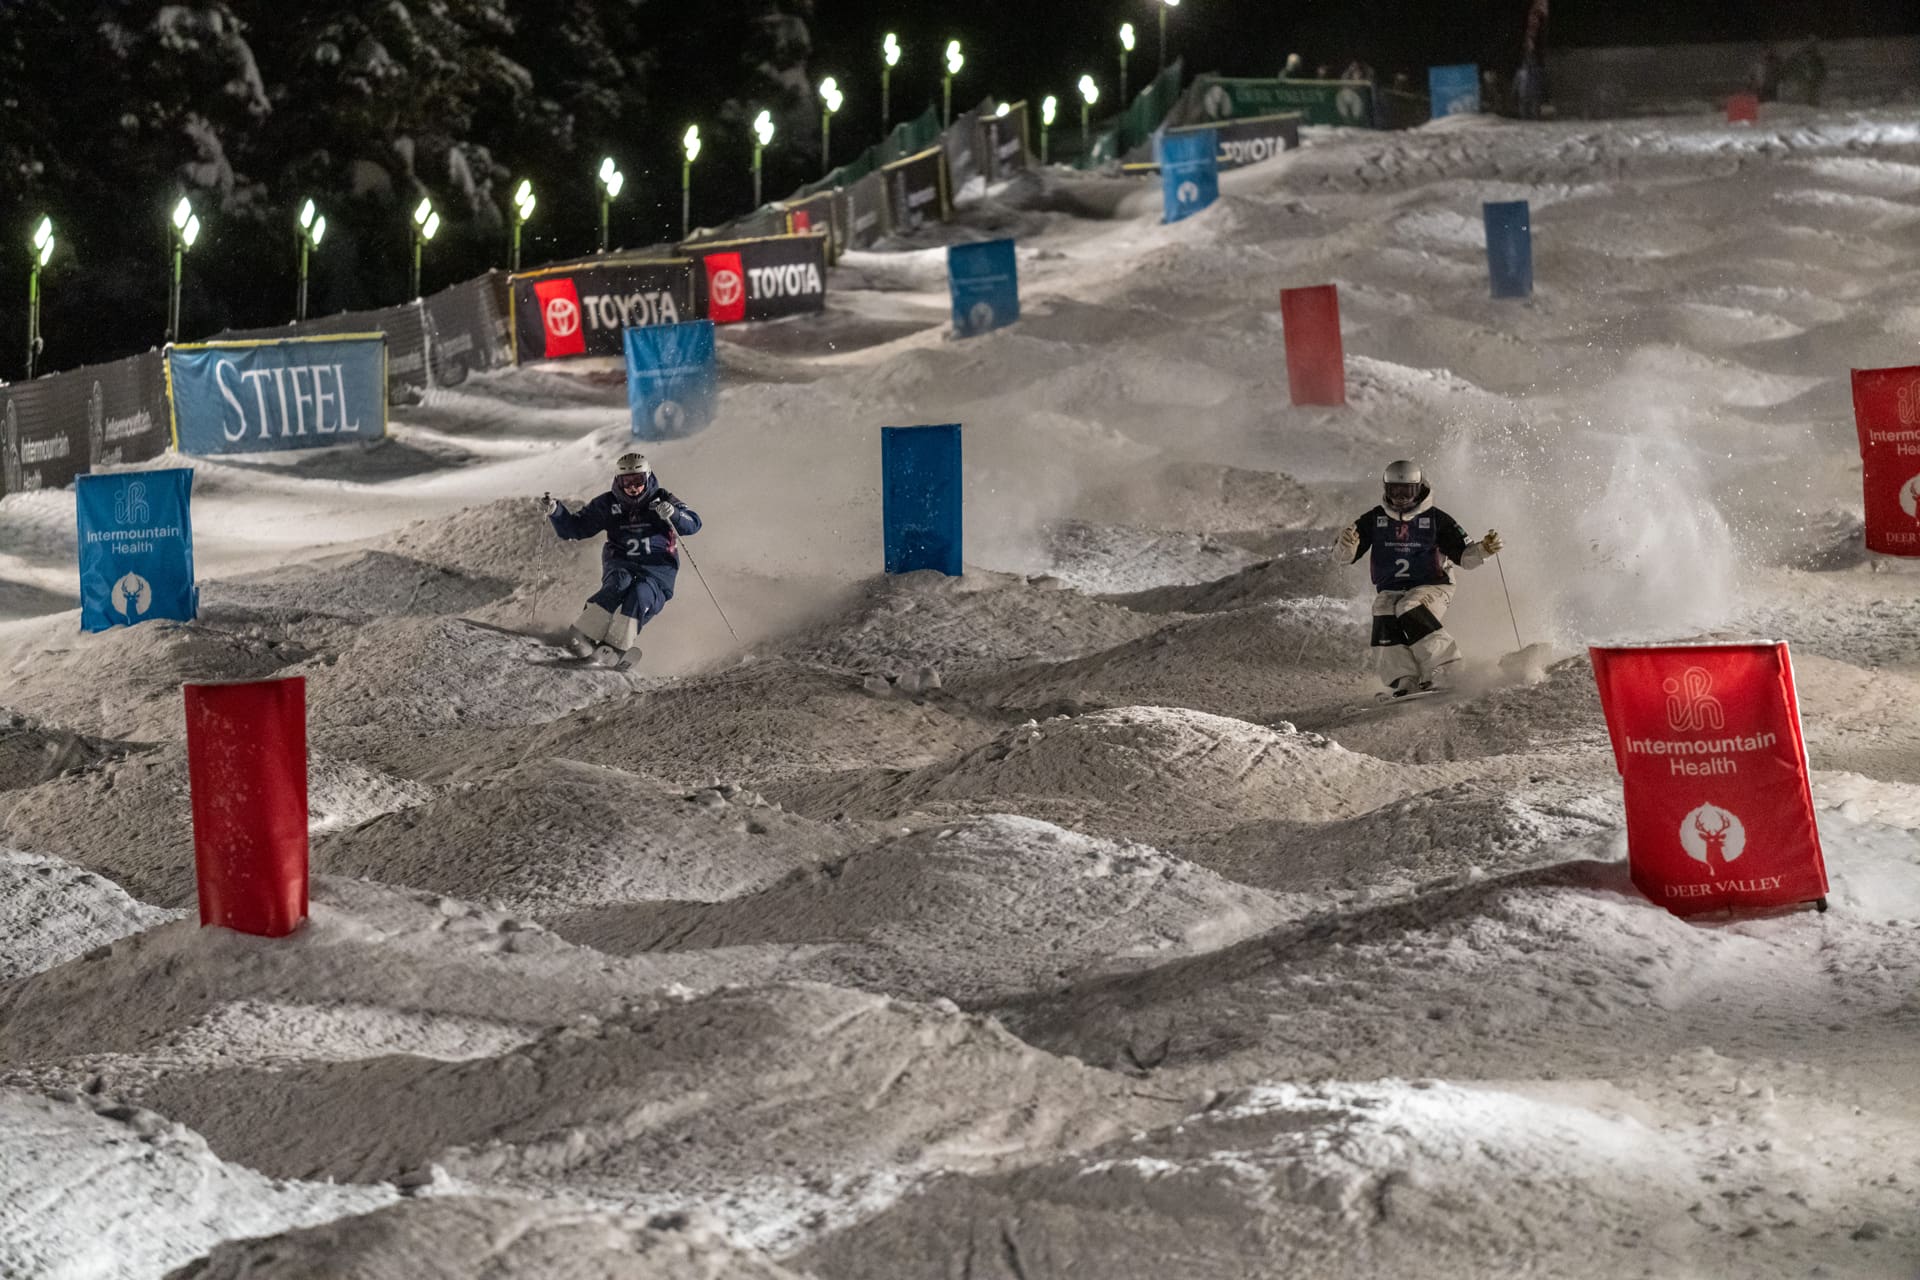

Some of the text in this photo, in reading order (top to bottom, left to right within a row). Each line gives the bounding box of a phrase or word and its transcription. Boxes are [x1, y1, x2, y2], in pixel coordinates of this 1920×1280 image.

[748, 263, 822, 299] TOYOTA
[583, 291, 679, 330] TOYOTA
[216, 359, 360, 442] STIFEL
[1869, 429, 1920, 442] Intermo
[1897, 443, 1920, 456] Hea
[87, 525, 180, 543] Intermountain
[1886, 532, 1918, 543] DEER
[111, 541, 153, 555] Health
[626, 537, 652, 556] 21
[1394, 558, 1410, 577] 2
[1626, 732, 1777, 755] Intermountain
[1670, 757, 1737, 776] Health
[1664, 875, 1782, 897] DEER VALLEY
